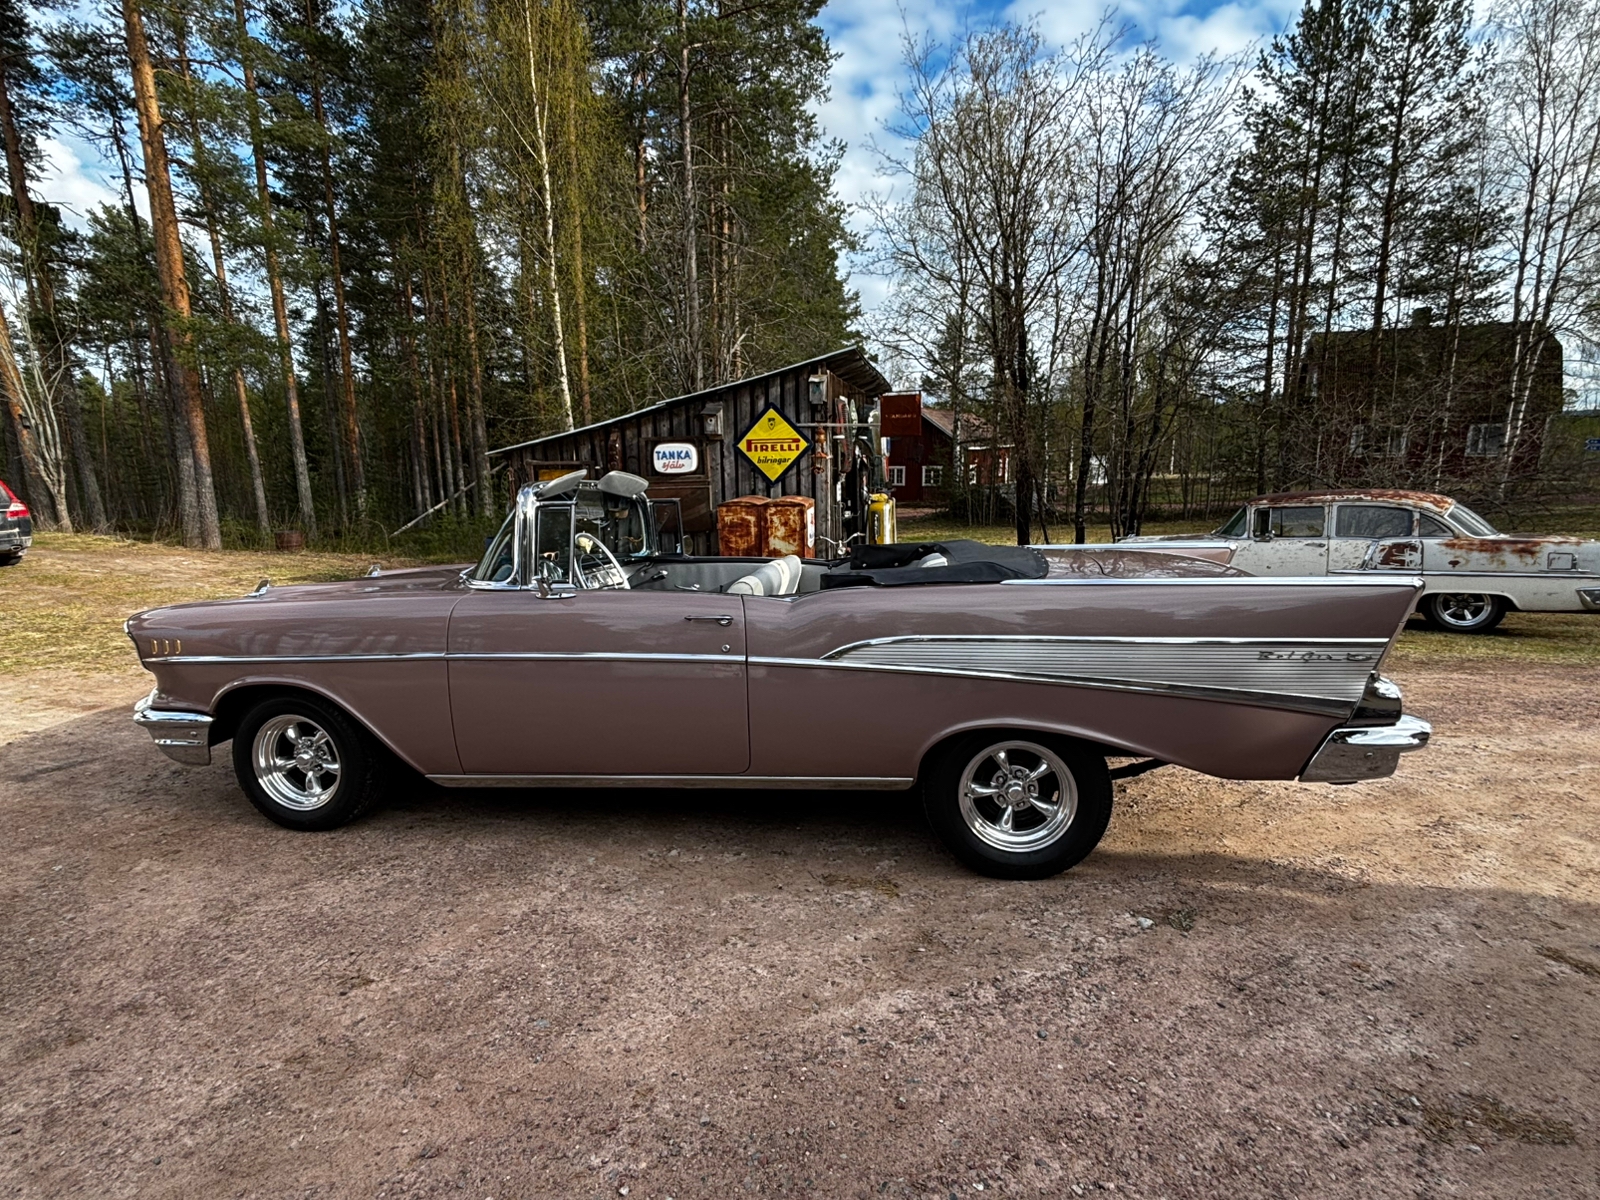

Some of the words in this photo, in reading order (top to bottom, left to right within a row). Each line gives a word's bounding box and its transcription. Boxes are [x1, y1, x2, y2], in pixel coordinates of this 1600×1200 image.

[746, 438, 801, 452] PIRELLI
[655, 450, 691, 461] TANKA
[757, 456, 791, 465] bilringar
[662, 460, 685, 471] själv
